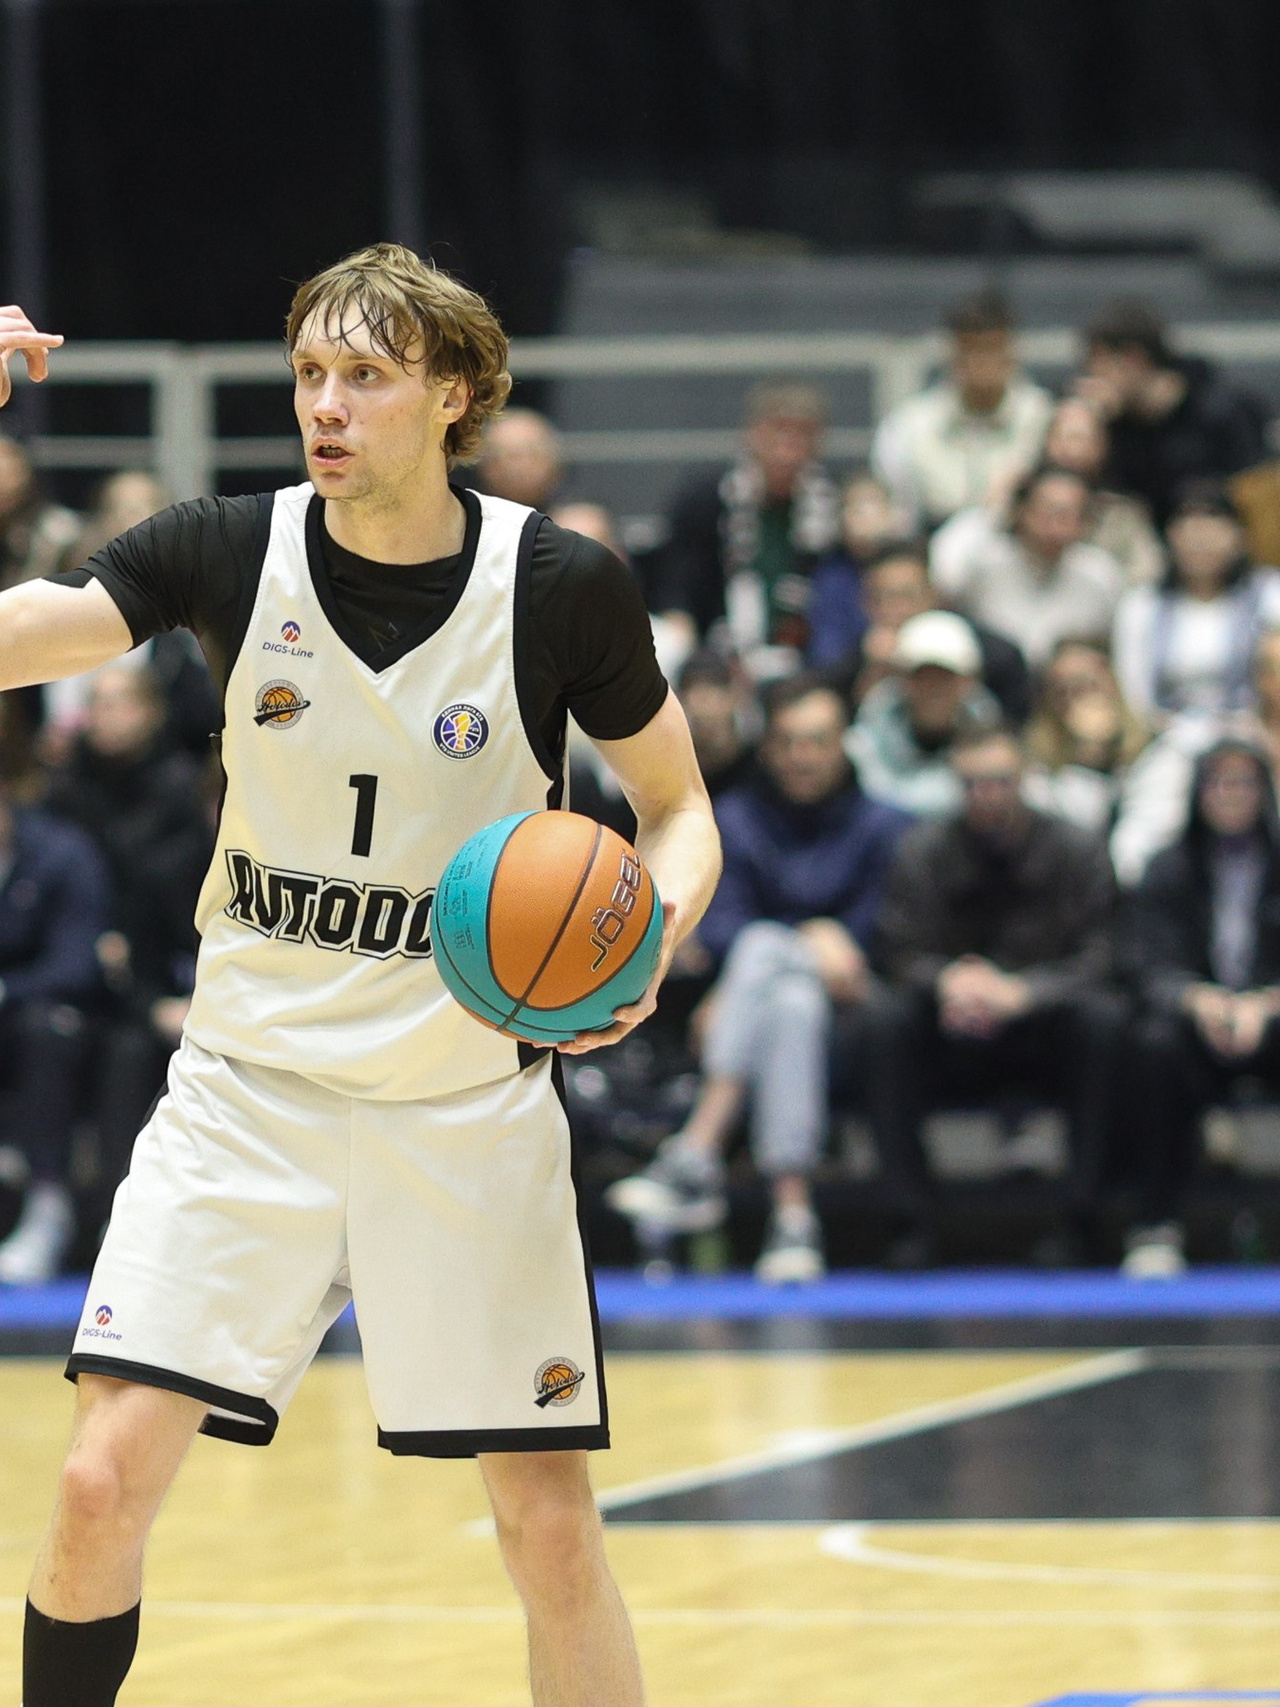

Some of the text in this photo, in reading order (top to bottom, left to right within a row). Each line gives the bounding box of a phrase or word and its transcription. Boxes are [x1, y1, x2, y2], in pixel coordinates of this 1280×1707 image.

[262, 641, 314, 658] DIGS-Line
[348, 773, 378, 857] 1
[224, 849, 435, 961] AVTODO
[82, 1328, 122, 1341] DIGS-Line
